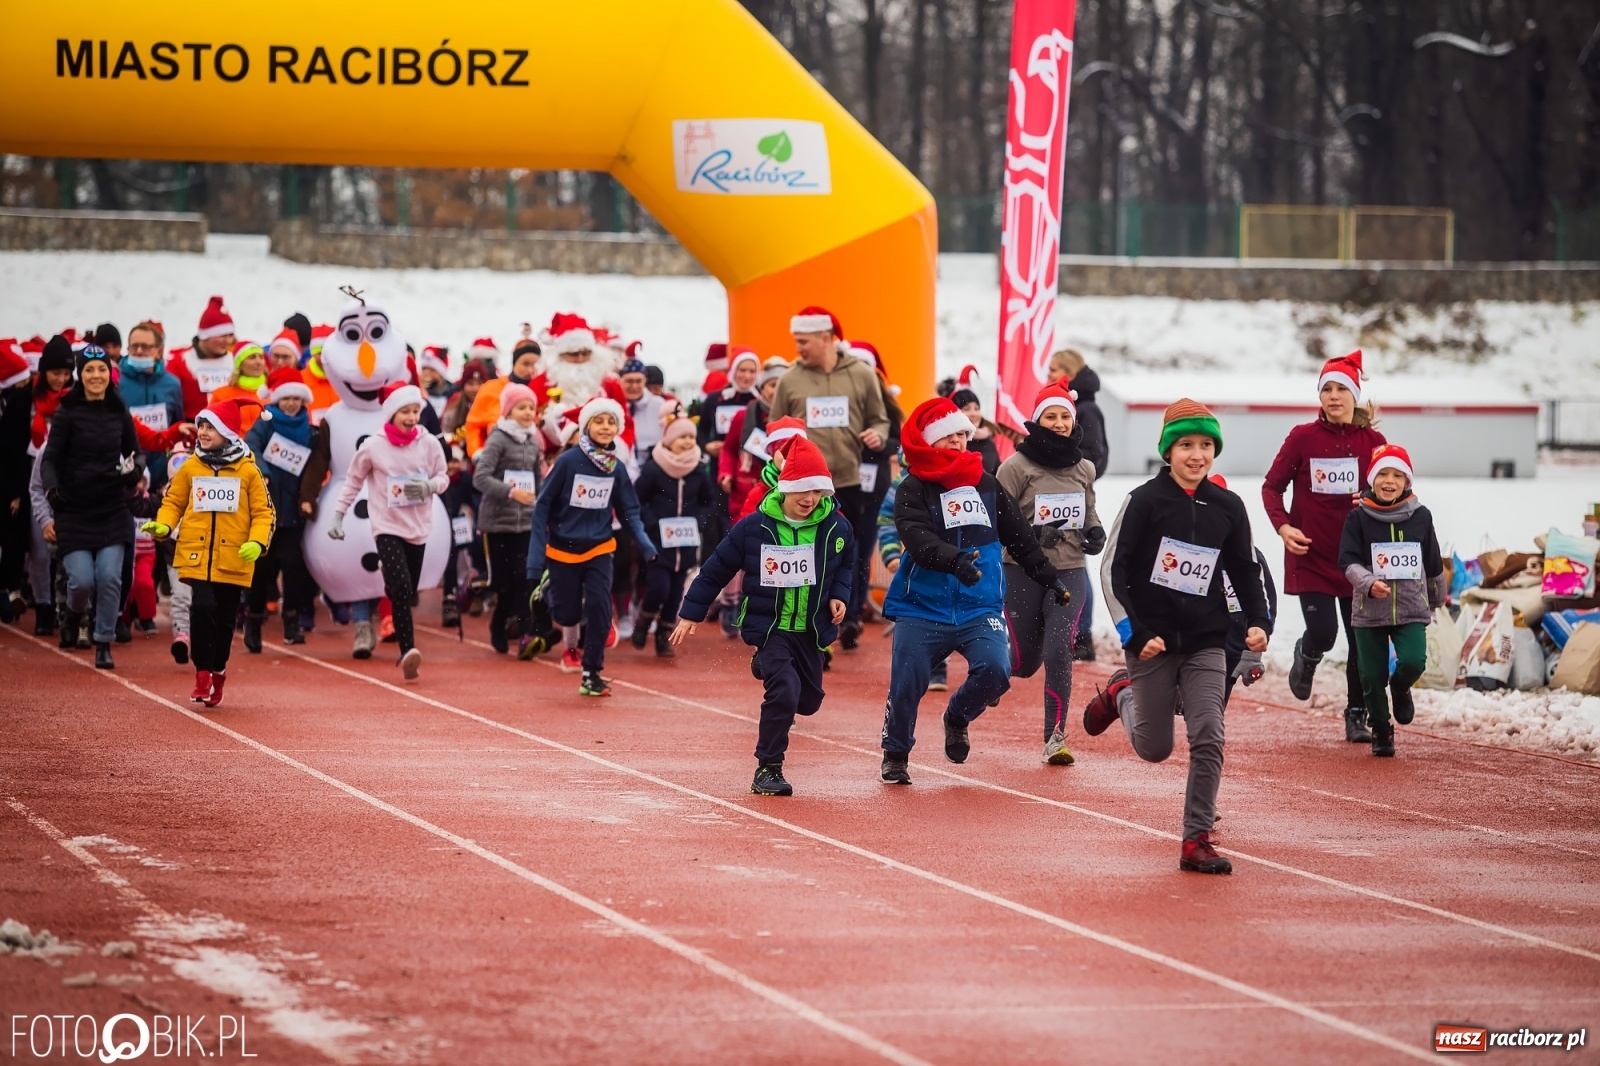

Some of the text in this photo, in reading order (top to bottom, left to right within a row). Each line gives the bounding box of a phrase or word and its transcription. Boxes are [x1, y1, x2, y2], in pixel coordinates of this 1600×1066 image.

[56, 38, 530, 87] MIASTO RACIBÓRZ
[821, 406, 845, 417] 030
[280, 448, 302, 465] 022
[1327, 470, 1355, 483] 040
[207, 488, 235, 501] 008
[587, 488, 609, 499] 047
[962, 500, 987, 515] 076
[1052, 505, 1080, 519] 005
[780, 559, 808, 575] 016
[1390, 554, 1418, 567] 038
[1179, 560, 1211, 580] 042
